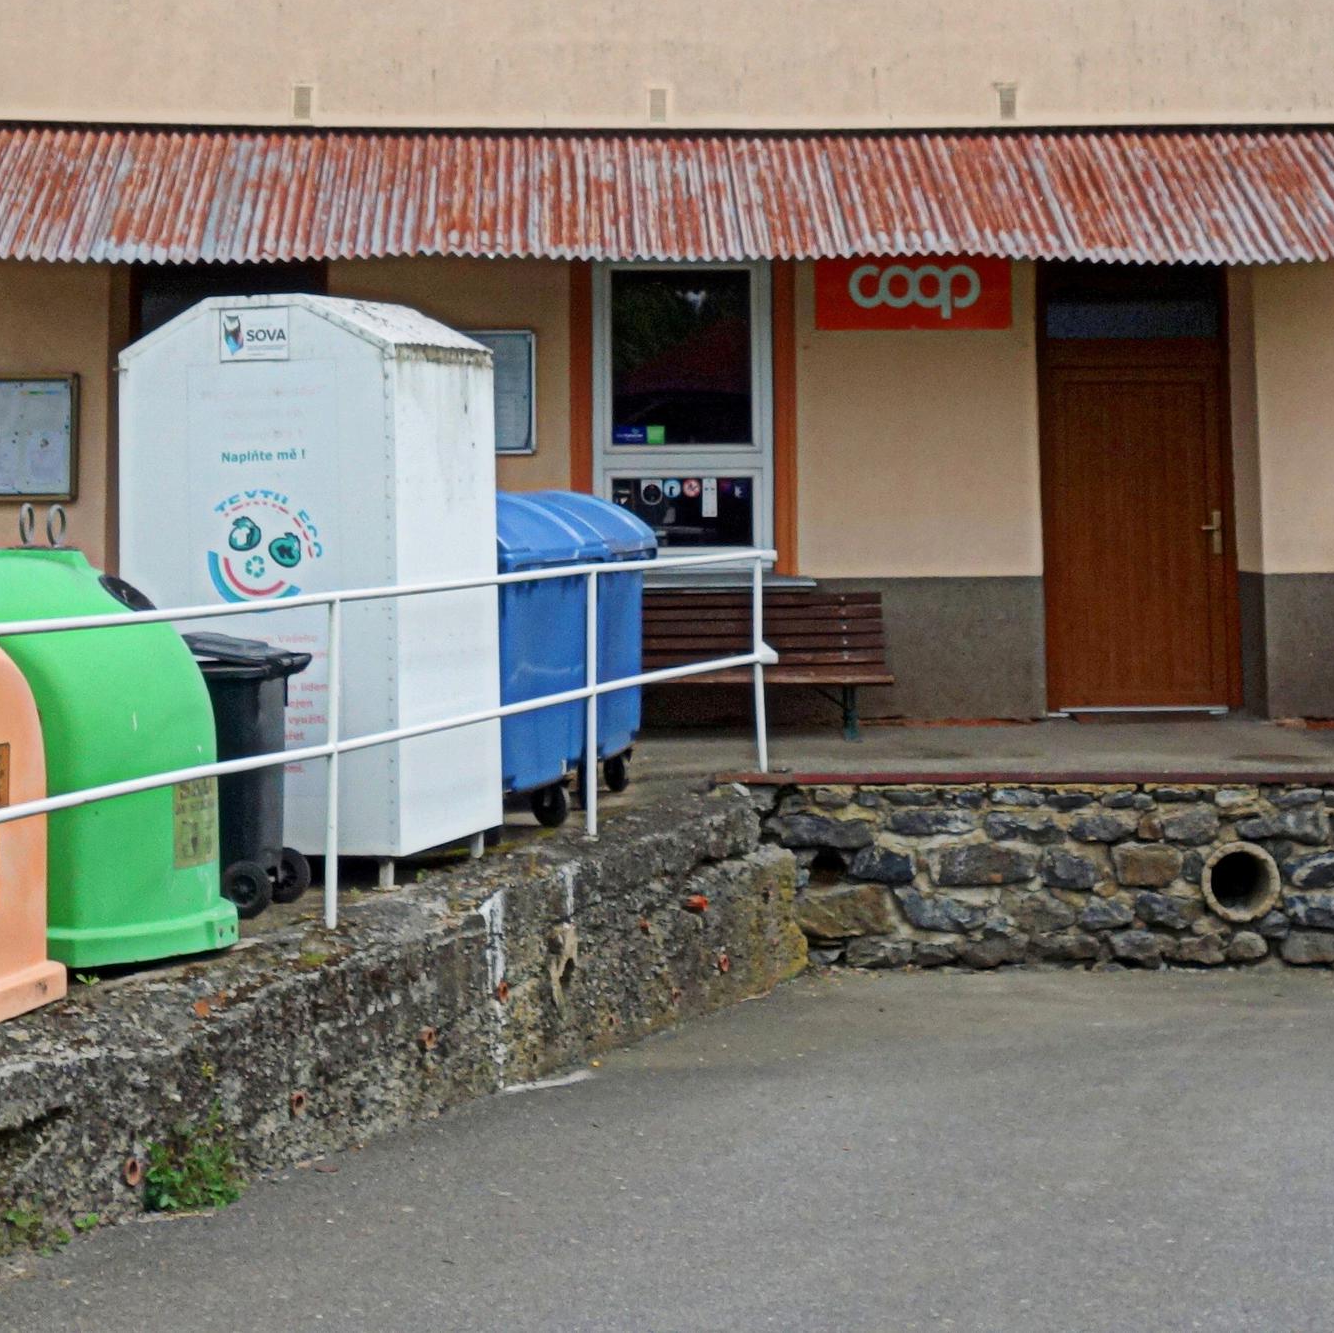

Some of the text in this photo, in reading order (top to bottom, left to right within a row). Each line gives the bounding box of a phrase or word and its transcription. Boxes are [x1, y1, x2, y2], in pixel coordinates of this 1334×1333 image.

[849, 265, 981, 319] coop
[246, 328, 286, 342] SOVA
[277, 448, 297, 460] mě
[214, 489, 322, 558] TEXTIL ECO
